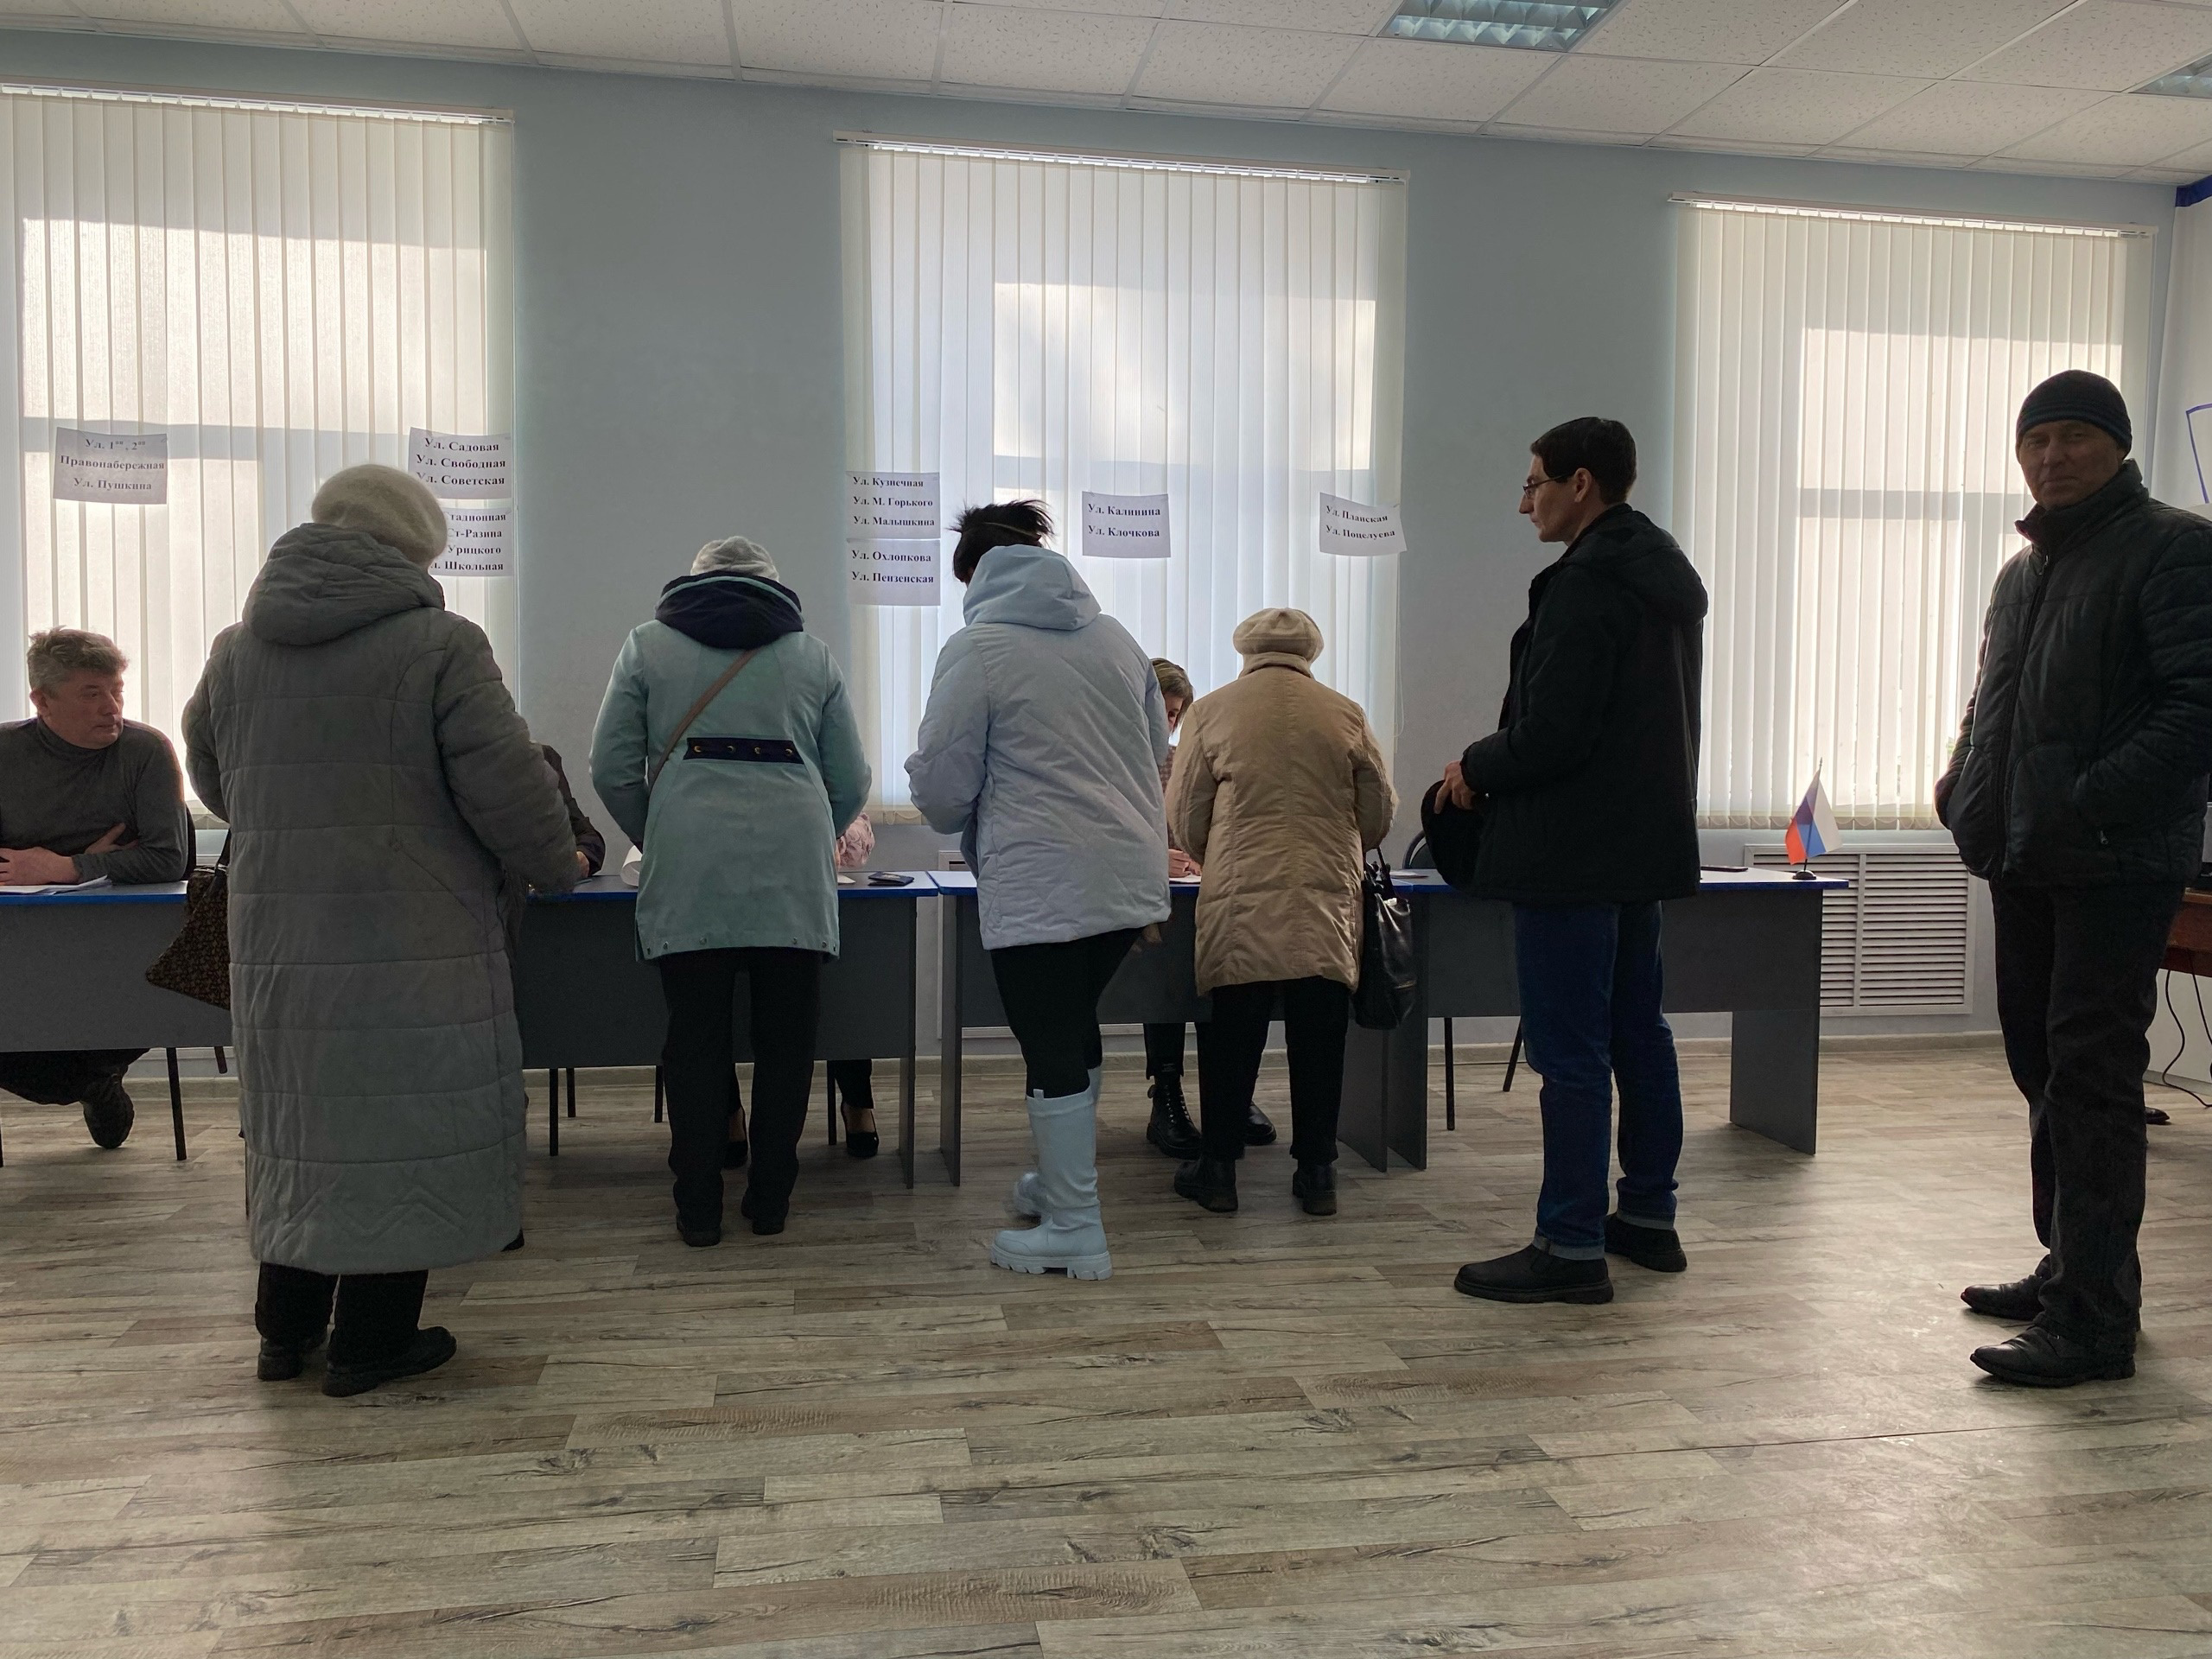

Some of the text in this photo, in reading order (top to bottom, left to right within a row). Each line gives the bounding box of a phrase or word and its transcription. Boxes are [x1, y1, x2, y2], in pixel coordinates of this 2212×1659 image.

[86, 439, 105, 449] Ул.
[425, 437, 499, 452] Ул. Садовая
[60, 454, 164, 471] Правонабережная
[416, 454, 505, 468] Ул. Свободная
[73, 477, 151, 491] Ул. Пушкина
[441, 474, 505, 485] Советская
[853, 476, 924, 488] Ул. Кузнечная
[853, 496, 933, 508] Ул. М. Горького
[1088, 503, 1161, 516] Ул. Калинина
[1326, 505, 1340, 517] Ул.
[853, 516, 935, 526] Ул. Малышкина
[1088, 524, 1160, 537] Ул. Клочкова
[1325, 524, 1395, 540] Ул. Поцелуева
[448, 544, 501, 556] Урицкого
[852, 550, 931, 562] Ул. Охлопкова
[445, 561, 504, 570] Школьная
[852, 571, 934, 583] Ул. Пензенская
